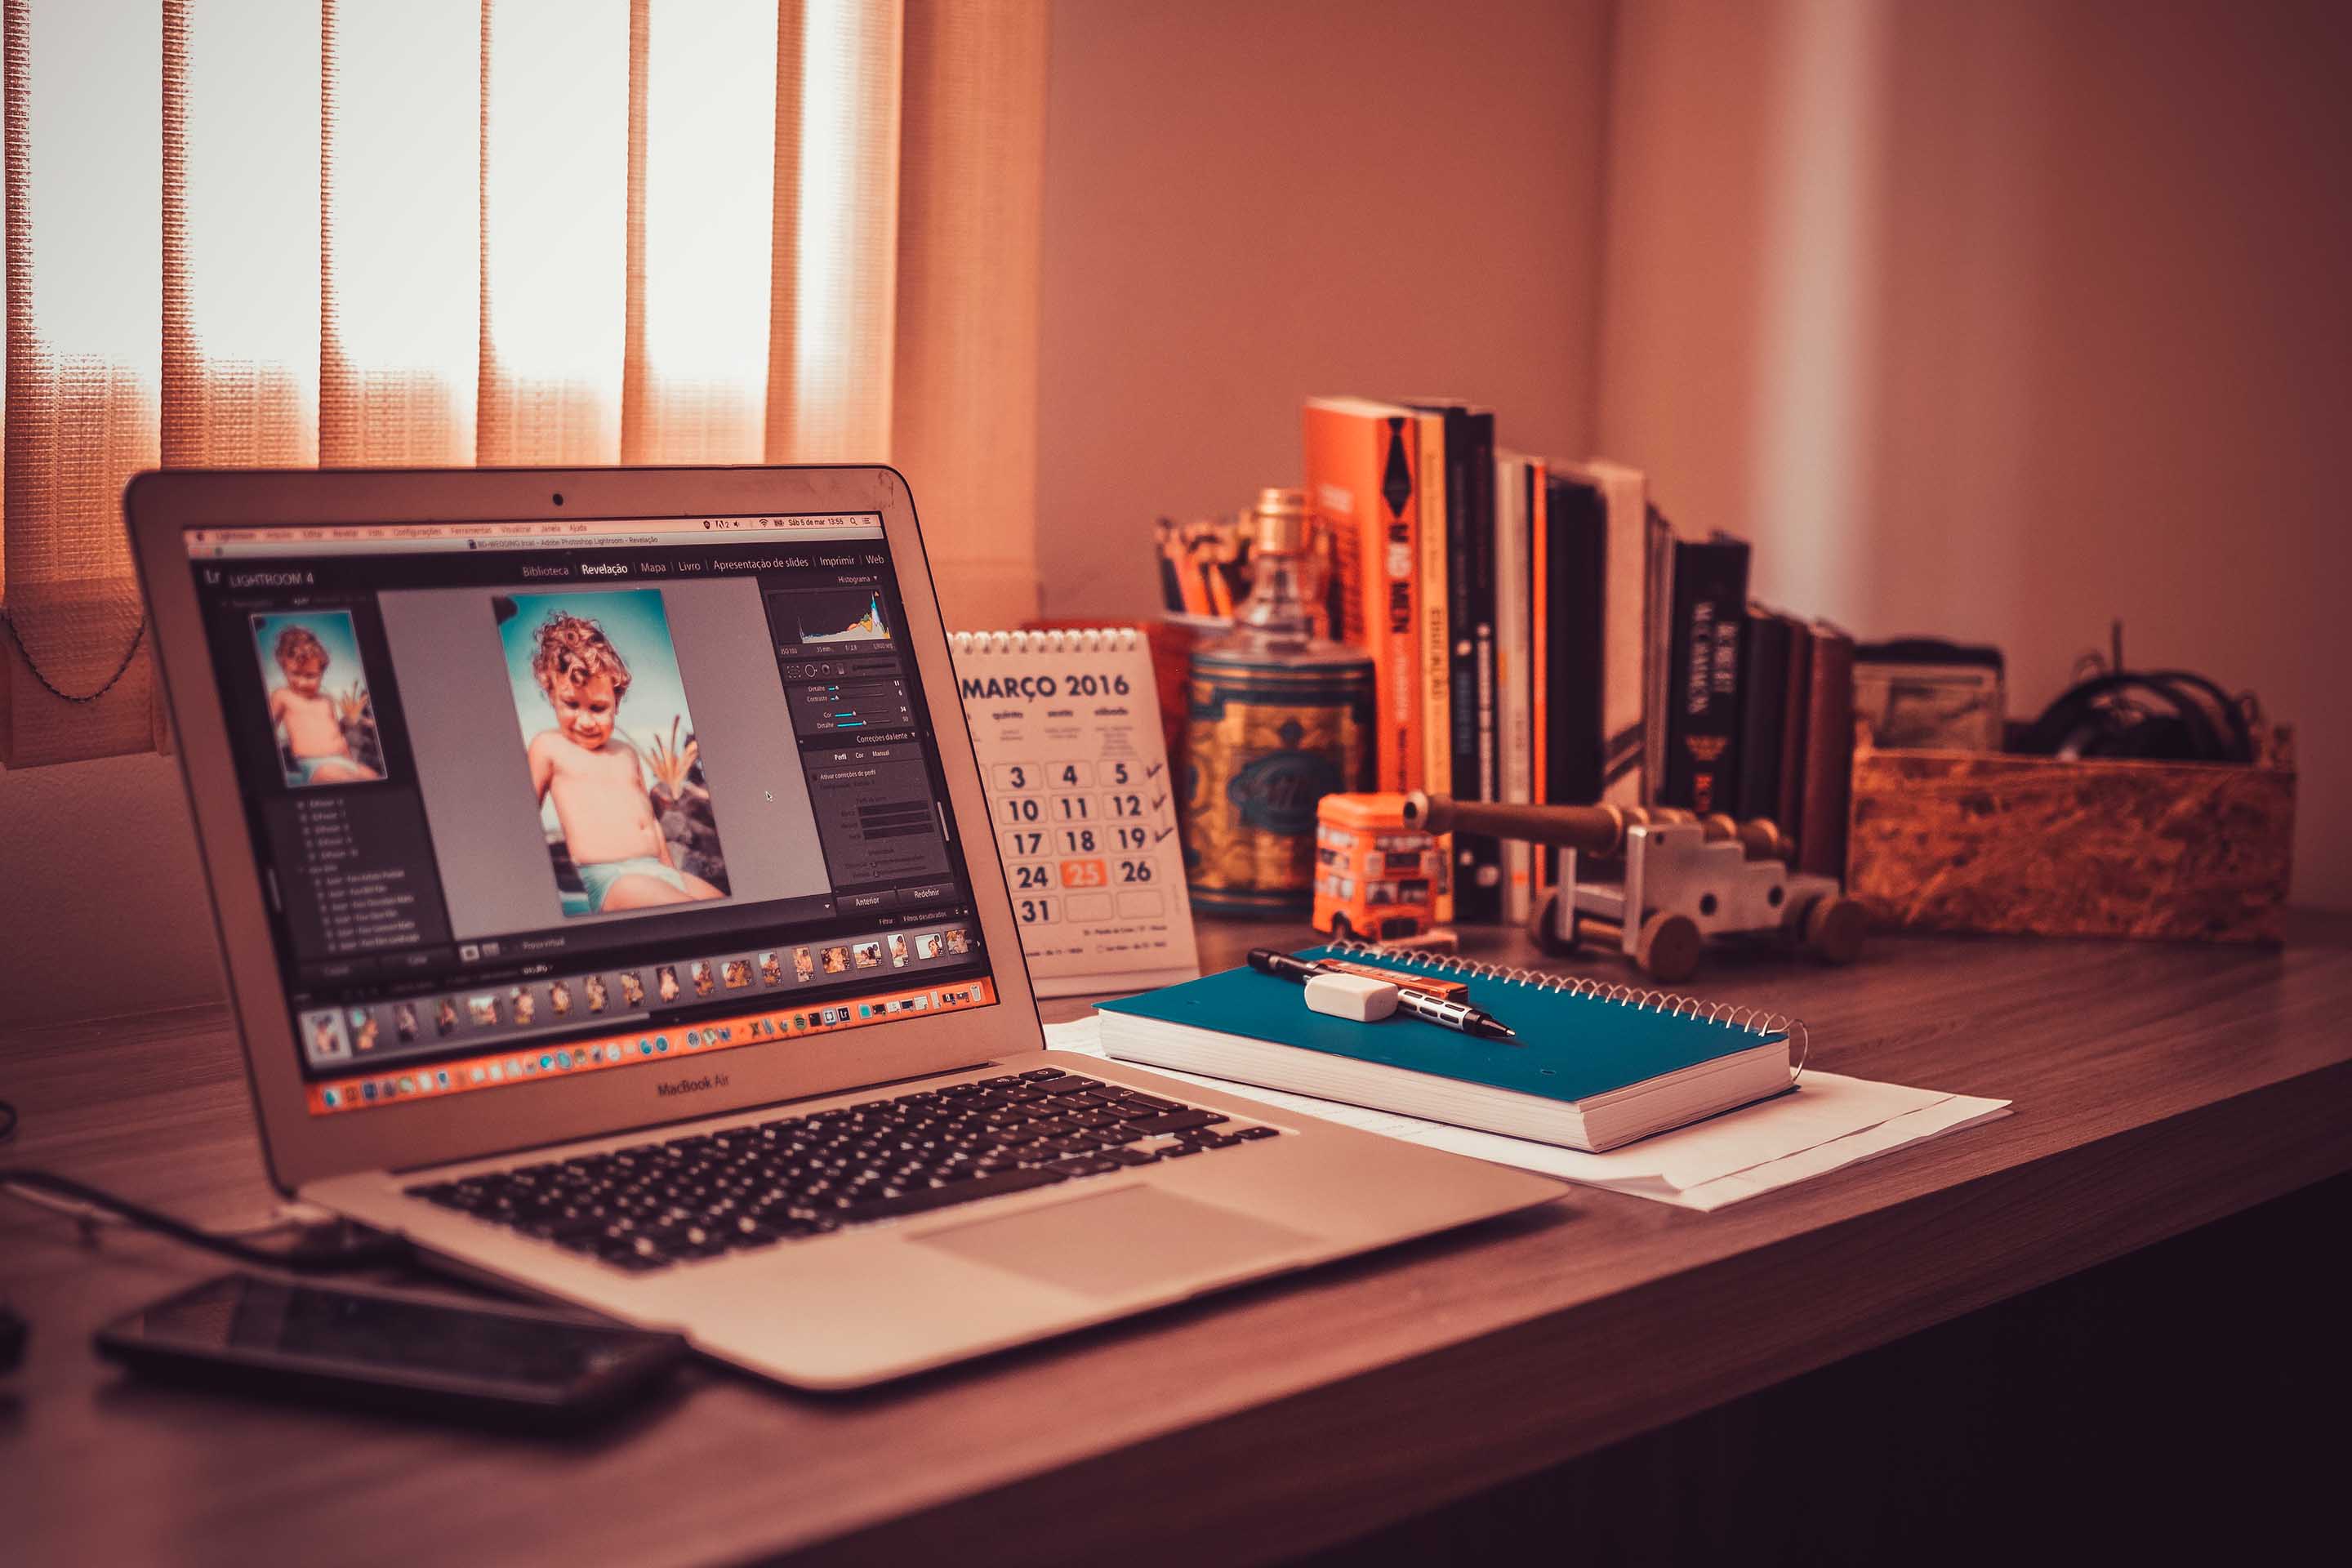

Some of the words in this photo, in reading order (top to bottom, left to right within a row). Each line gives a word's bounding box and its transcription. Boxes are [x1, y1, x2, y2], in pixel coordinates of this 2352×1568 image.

[679, 561, 701, 572] Livro
[713, 558, 772, 572] Apresentação
[773, 558, 784, 568] de
[784, 557, 809, 568] slides
[819, 556, 855, 569] Imprimir
[865, 555, 884, 565] Web
[522, 566, 569, 577] Biblioteca
[581, 564, 628, 576] Revelação
[641, 562, 666, 573] Mapa
[229, 572, 302, 587] LIGHTROOM
[306, 572, 314, 584] 4
[837, 575, 871, 585] Histograma
[961, 675, 1057, 702] MARÇO
[1065, 675, 1130, 697] 2016
[856, 733, 885, 744] Correções
[893, 731, 908, 741] lente
[855, 751, 864, 760] Cor
[835, 770, 857, 780] correções
[1010, 766, 1026, 789] 3
[1062, 765, 1078, 786] 4
[1116, 763, 1128, 784] 5
[1009, 799, 1039, 822] 10
[1062, 797, 1087, 818] 11
[1113, 795, 1142, 817] 12
[1014, 832, 1042, 854] 17
[1067, 830, 1095, 852] 18
[1118, 827, 1146, 849] 19
[1017, 866, 1048, 889] 24
[1068, 862, 1100, 885] 25
[1121, 861, 1152, 882] 26
[914, 888, 940, 898] Redefinir
[855, 896, 880, 907] Anterior
[1021, 900, 1049, 923] 31
[657, 1076, 711, 1097] MacBook
[715, 1074, 729, 1087] Air
